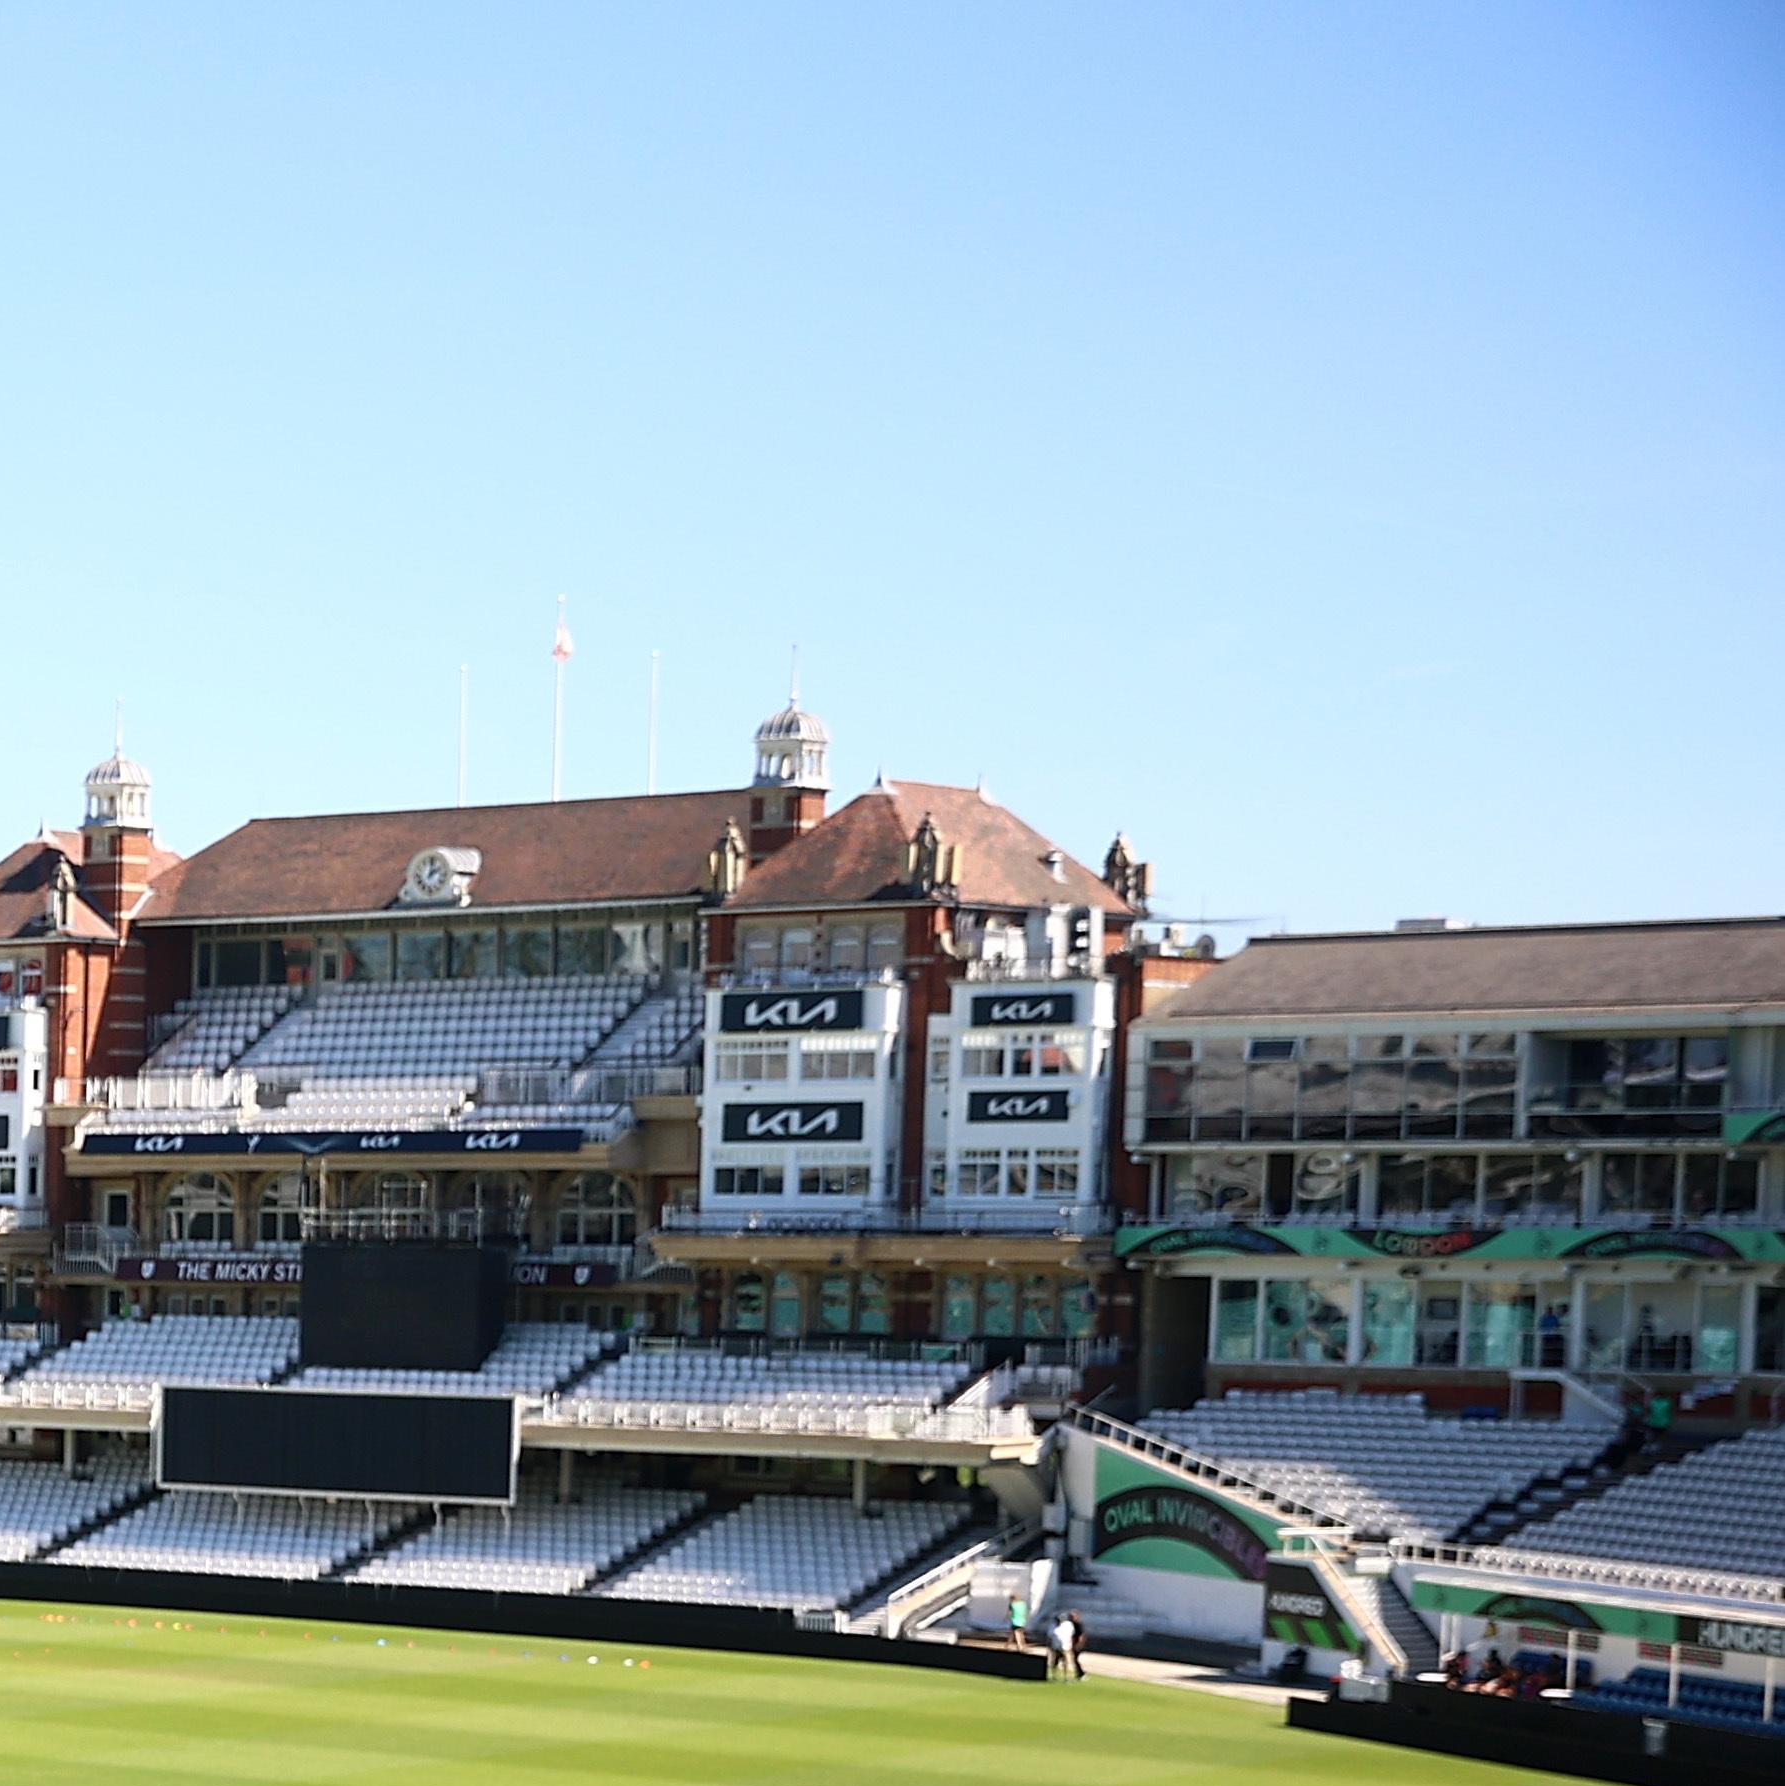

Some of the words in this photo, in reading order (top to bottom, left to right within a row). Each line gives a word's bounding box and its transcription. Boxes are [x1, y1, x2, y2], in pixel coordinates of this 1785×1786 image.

[177, 1261, 210, 1280] THE
[214, 1261, 271, 1281] MICKY
[1104, 1504, 1153, 1533] OVAL
